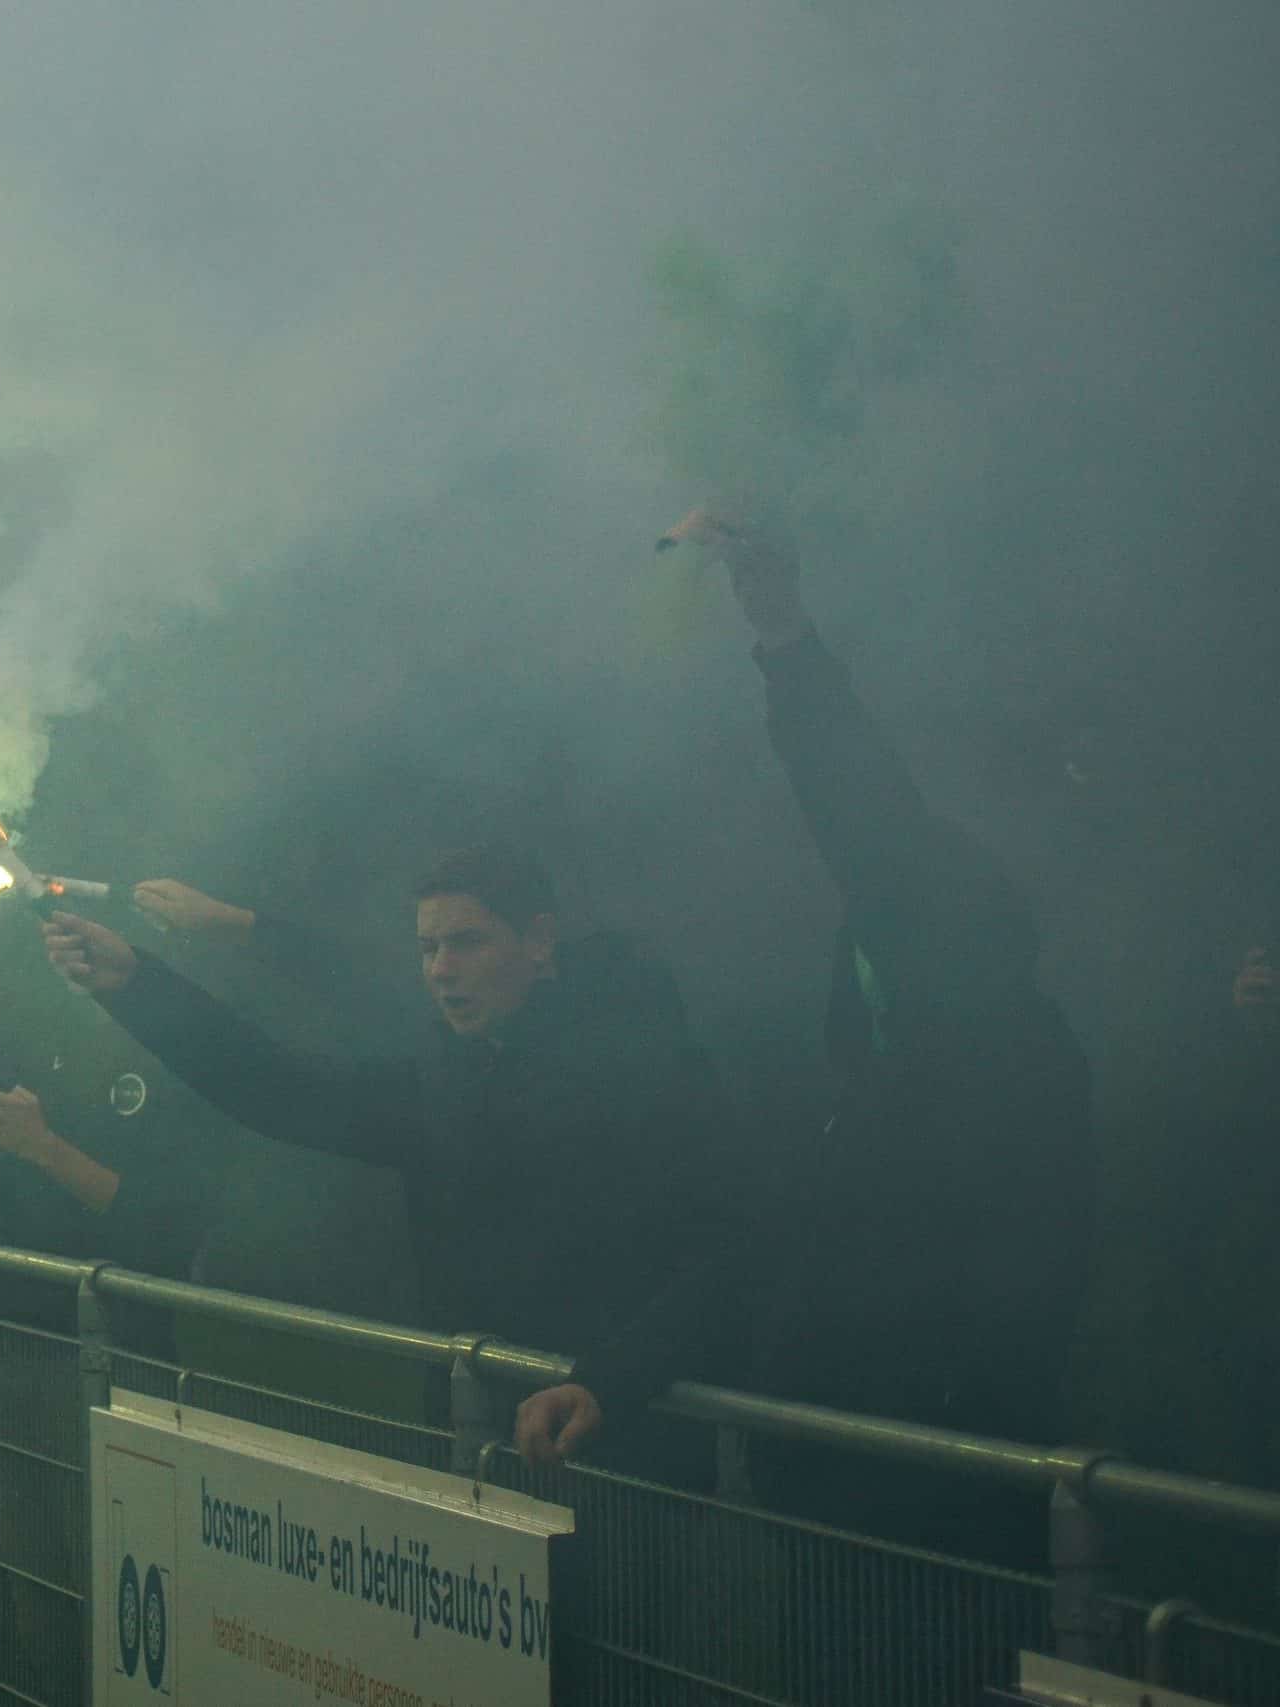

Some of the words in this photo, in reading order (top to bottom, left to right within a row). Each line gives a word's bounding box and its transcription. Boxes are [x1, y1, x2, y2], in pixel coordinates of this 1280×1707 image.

[201, 1477, 271, 1567] bosman
[277, 1500, 324, 1583] luxe-
[330, 1534, 354, 1596] en
[360, 1525, 512, 1649] bedrijfsauto's
[520, 1573, 549, 1660] bv
[298, 1648, 313, 1685] en
[315, 1649, 366, 1706] gebruikte
